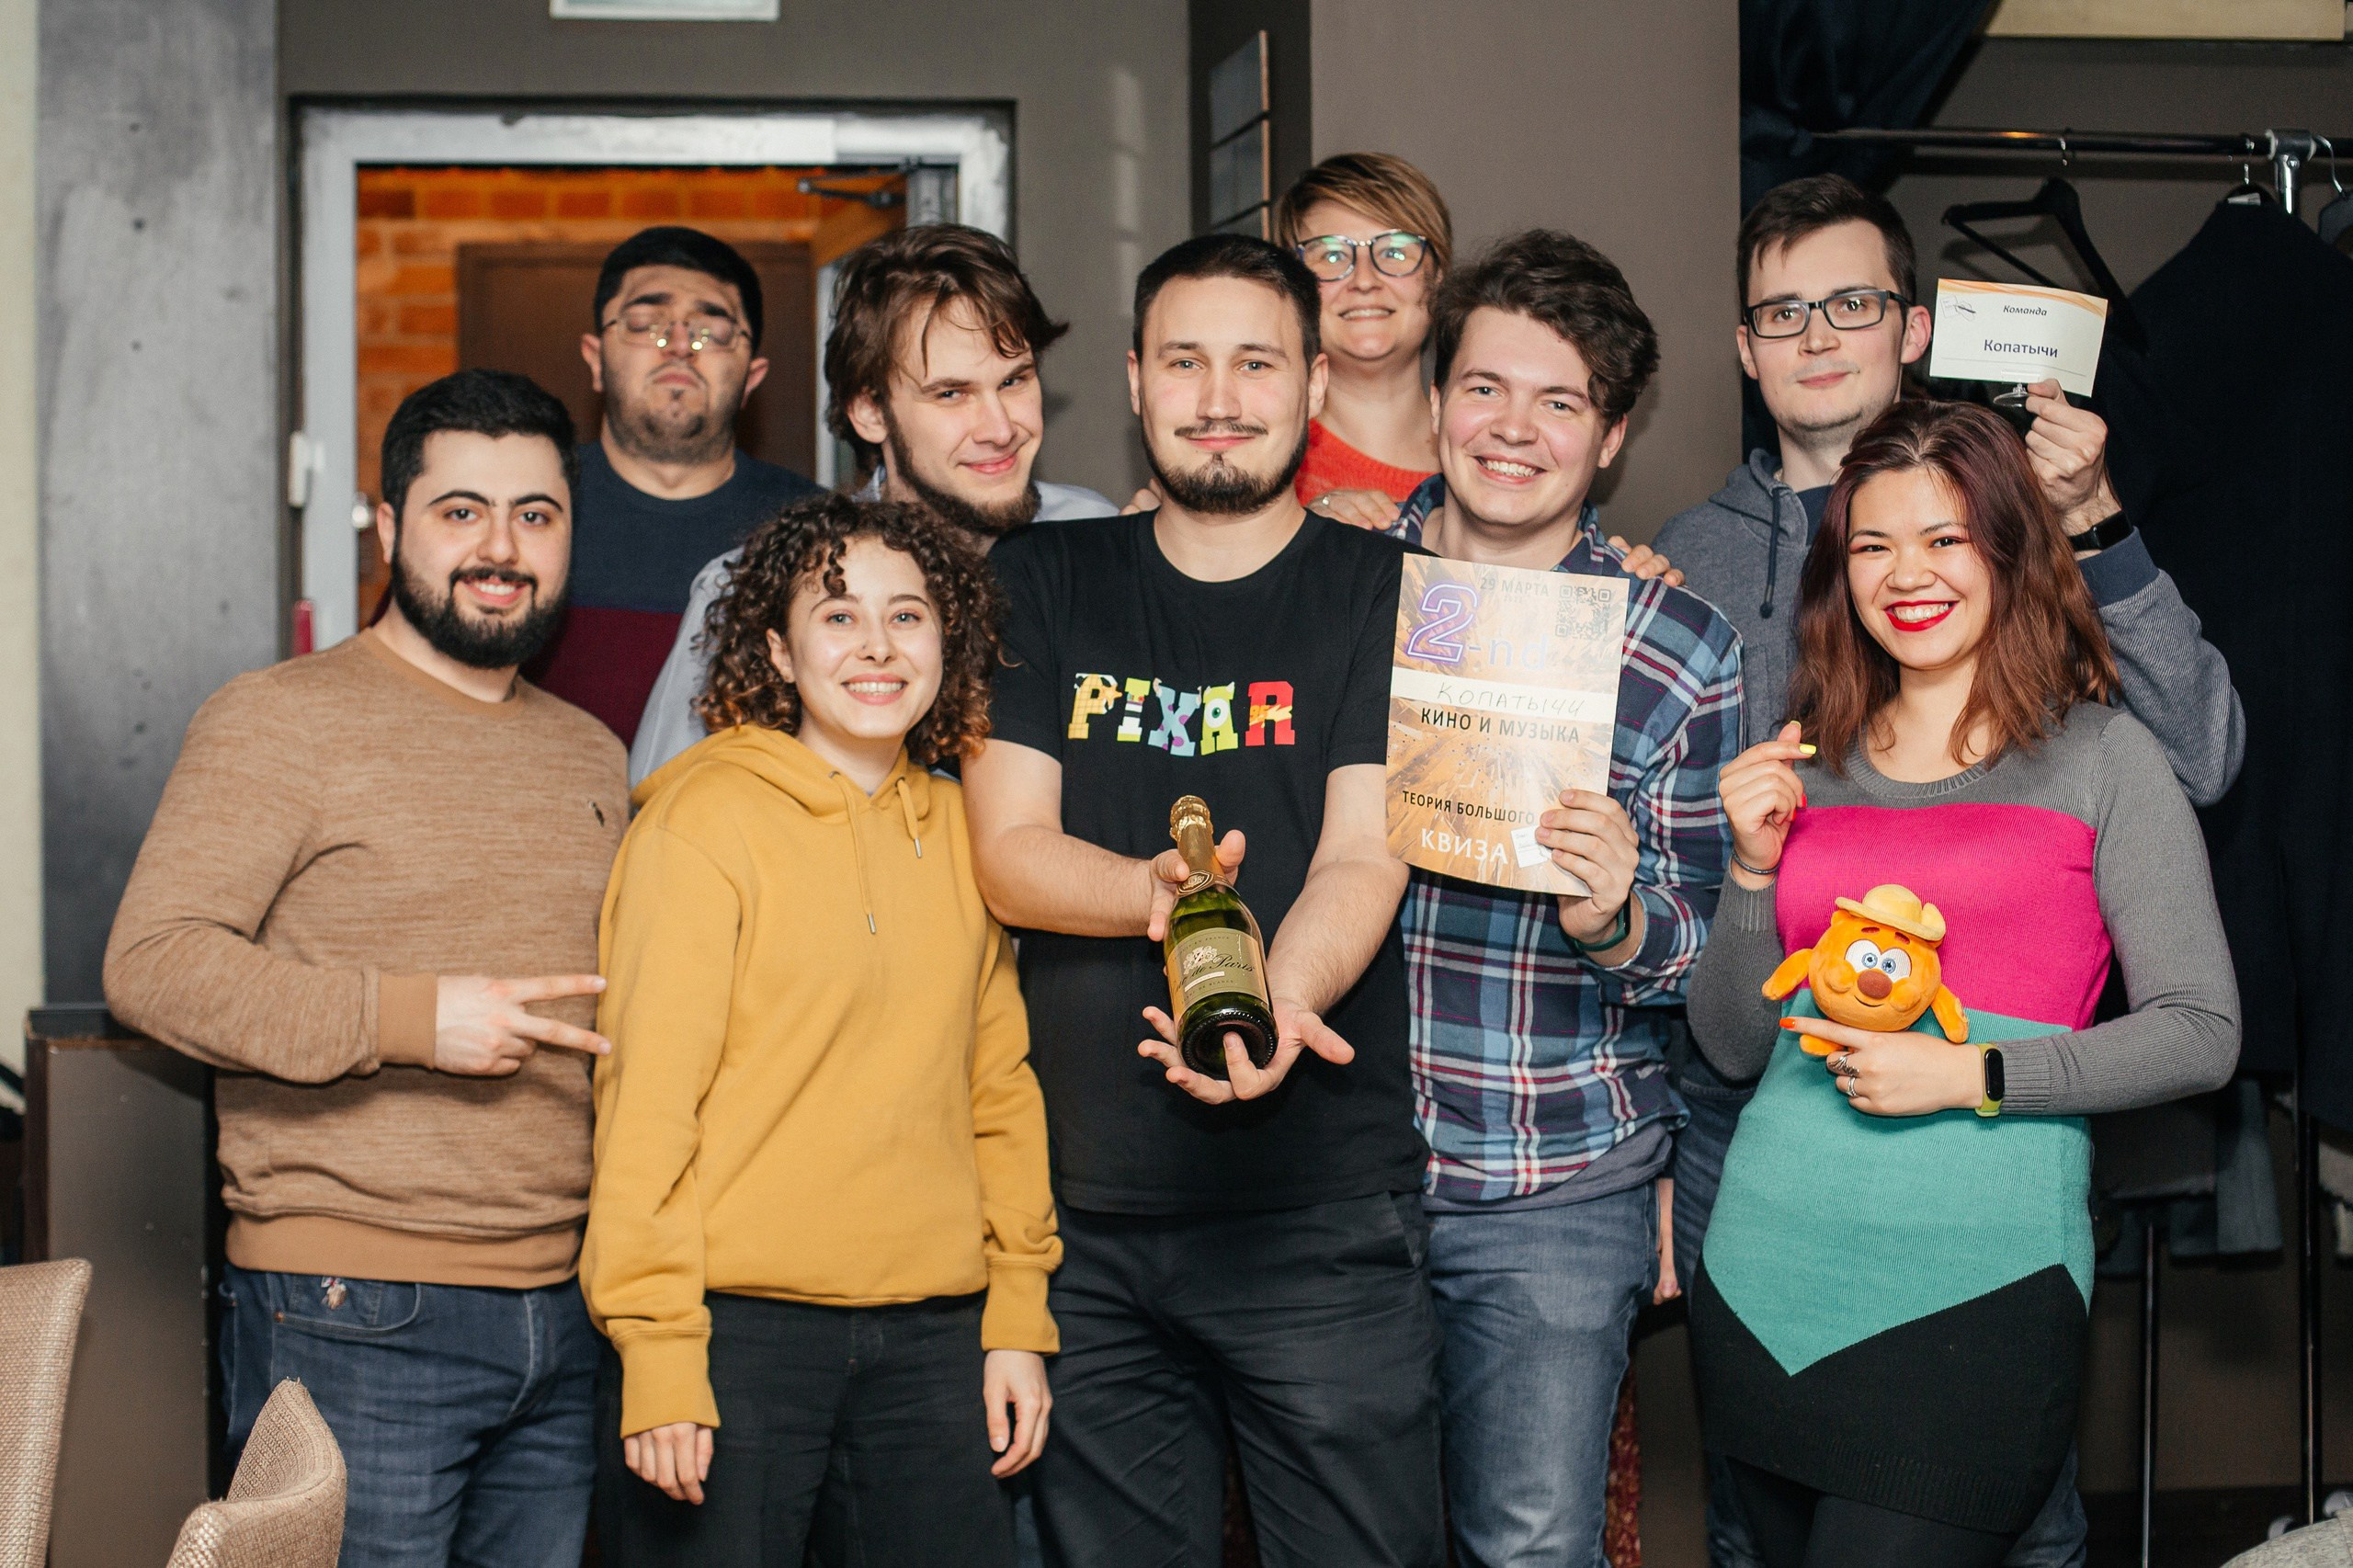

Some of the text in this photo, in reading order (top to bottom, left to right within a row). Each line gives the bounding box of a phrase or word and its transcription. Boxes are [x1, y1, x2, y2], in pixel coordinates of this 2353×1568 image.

[2003, 304, 2048, 316] Команда
[1984, 338, 2058, 358] Копатычи
[1480, 577, 1549, 597] 29 МАРТА
[1068, 672, 1295, 756] PIXAR
[1421, 708, 1580, 744] КИНО И МУЗЫКА
[1403, 790, 1535, 824] ТЕОРИЯ БОЛЬШОГО
[1421, 828, 1508, 865] КВИЗА
[1209, 953, 1256, 972] Paris
